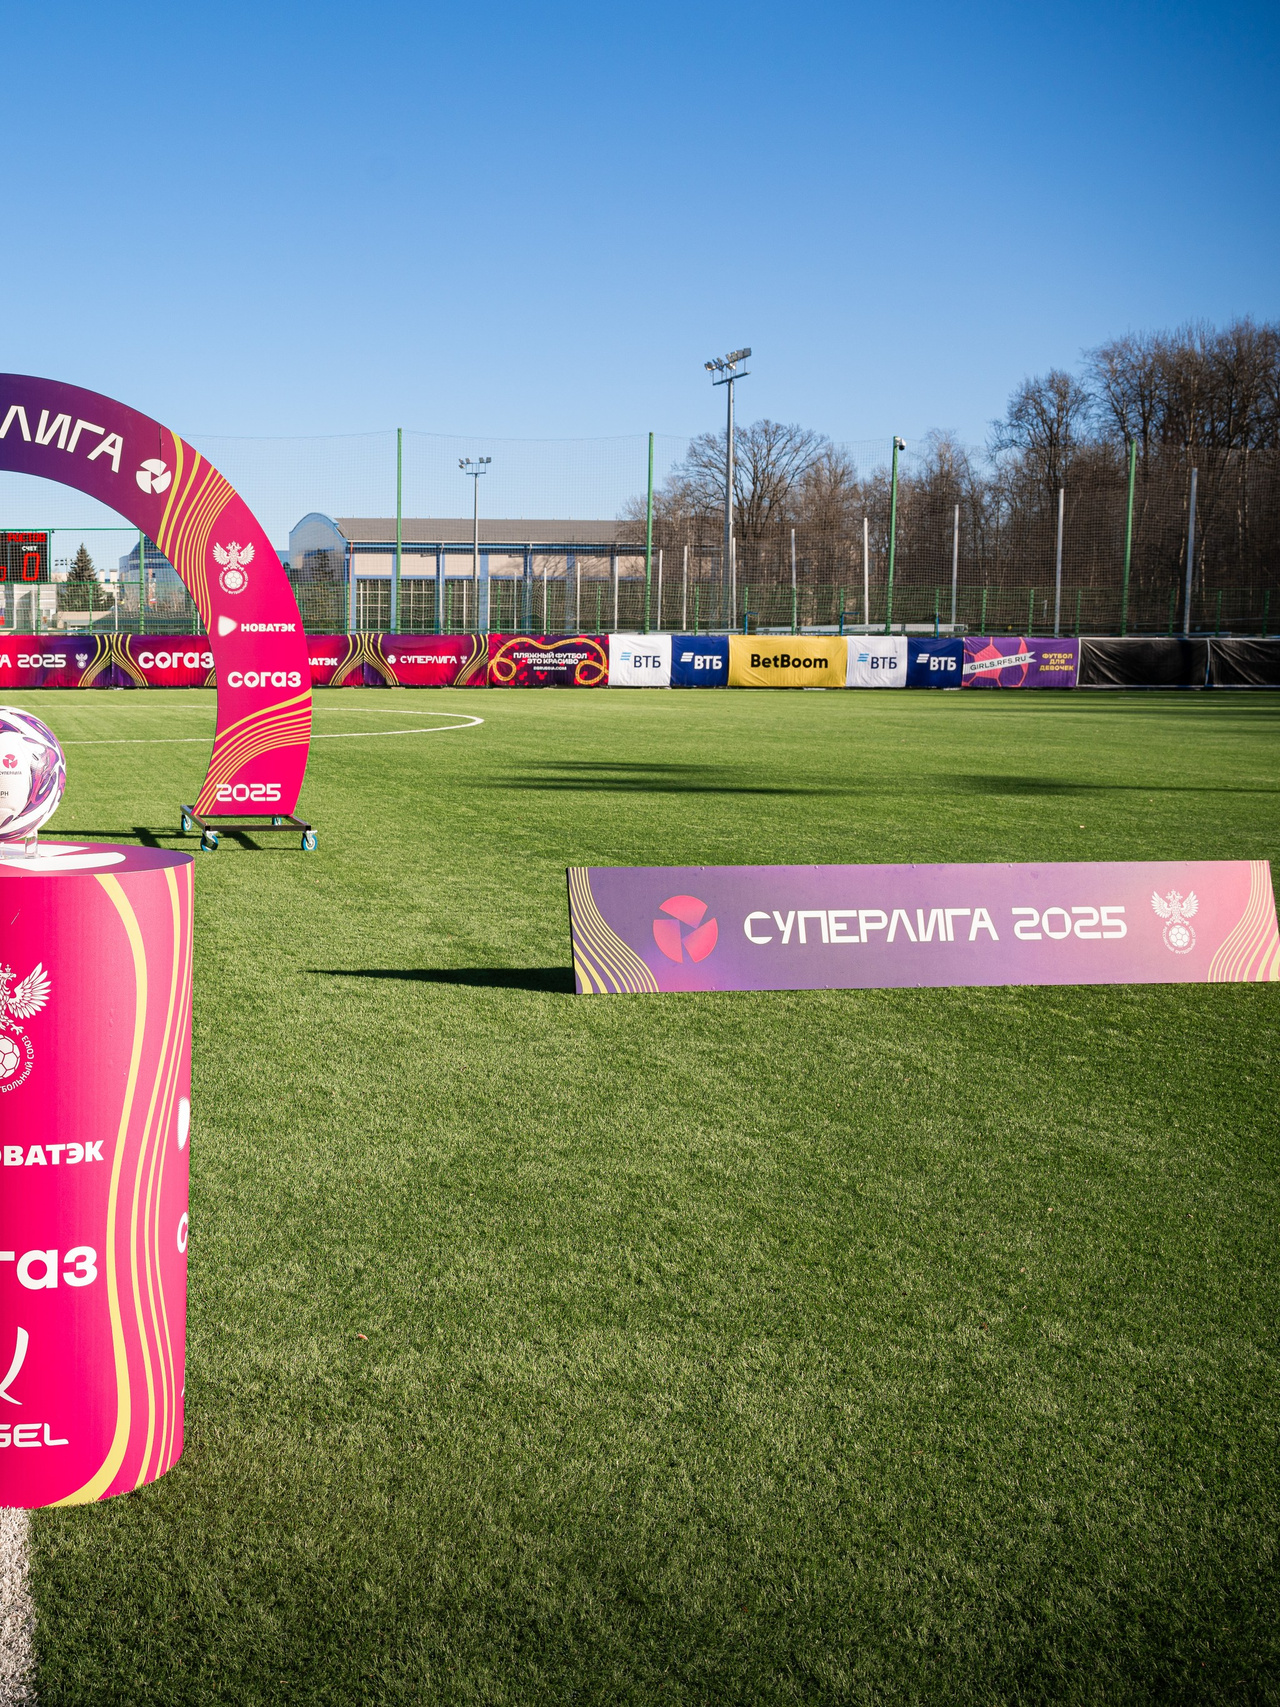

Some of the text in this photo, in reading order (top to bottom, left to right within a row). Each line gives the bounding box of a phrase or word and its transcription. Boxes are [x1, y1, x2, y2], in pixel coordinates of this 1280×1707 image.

[8, 532, 46, 543] РОСТОВ
[22, 552, 41, 581] 0
[240, 624, 296, 633] НОВАТЭК
[17, 654, 67, 668] 2025
[400, 655, 458, 665] СУПЕРЛИГА
[634, 655, 661, 669] ВТБ
[694, 655, 723, 670] ВТБ
[751, 654, 828, 669] BetBoom
[870, 656, 897, 670] ВТБ
[929, 655, 956, 671] ВТБ
[970, 656, 1027, 671] GIRLS.RFS.RU
[215, 782, 281, 802] 2025
[743, 907, 999, 944] СУПЕРЛИГА
[1012, 905, 1127, 940] 2025
[21, 1035, 35, 1060] СОЮЗ
